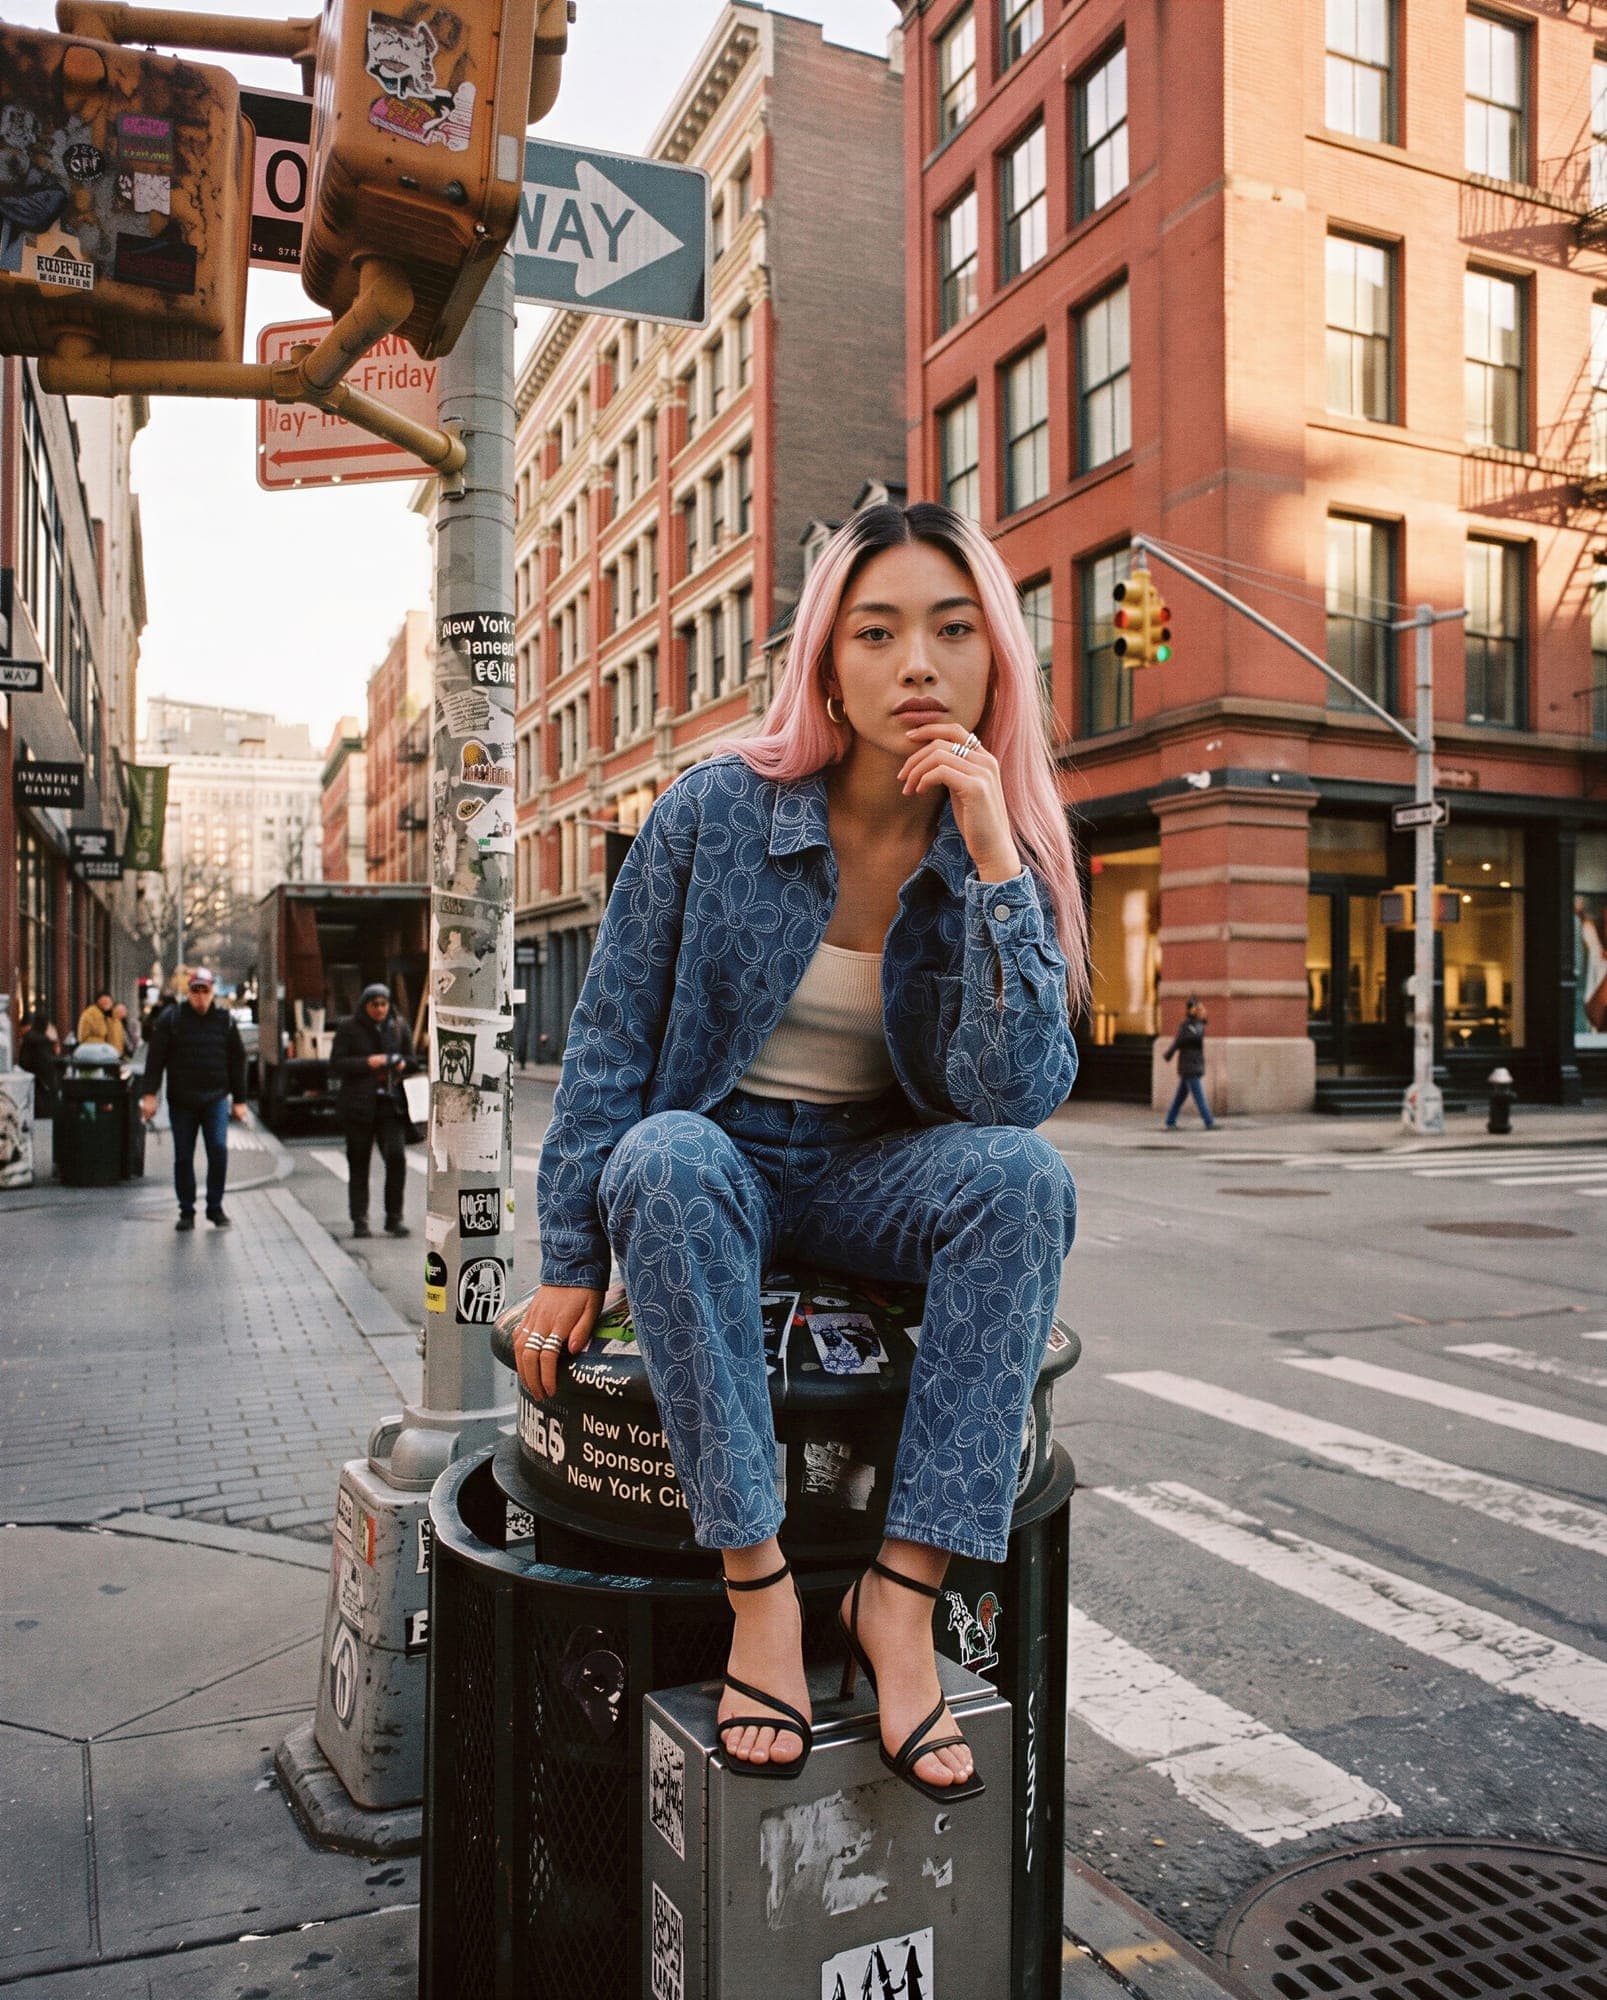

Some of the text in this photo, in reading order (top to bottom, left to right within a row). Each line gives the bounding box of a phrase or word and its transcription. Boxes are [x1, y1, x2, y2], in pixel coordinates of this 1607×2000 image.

[345, 363, 437, 394] -Friday
[442, 615, 511, 639] New York
[583, 1413, 671, 1449] New York
[583, 1441, 676, 1478] Sponsors
[567, 1464, 689, 1509] New York Cit
